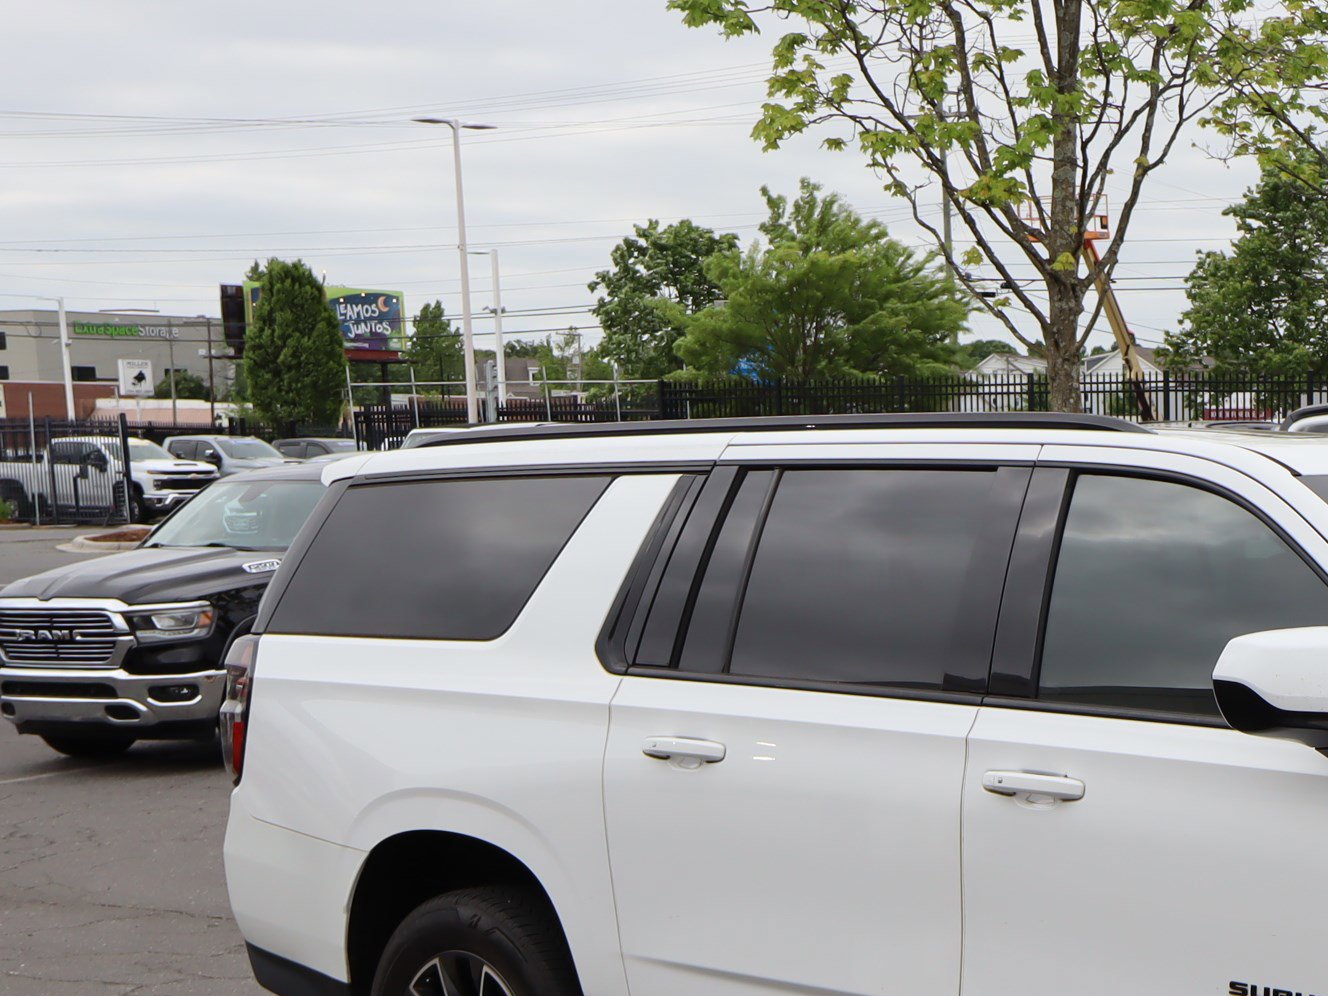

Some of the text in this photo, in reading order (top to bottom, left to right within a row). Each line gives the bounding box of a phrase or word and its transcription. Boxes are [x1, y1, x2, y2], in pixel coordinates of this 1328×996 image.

[336, 303, 379, 320] LEAMOS
[344, 321, 391, 338] JUNTOS
[19, 629, 71, 640] RAM
